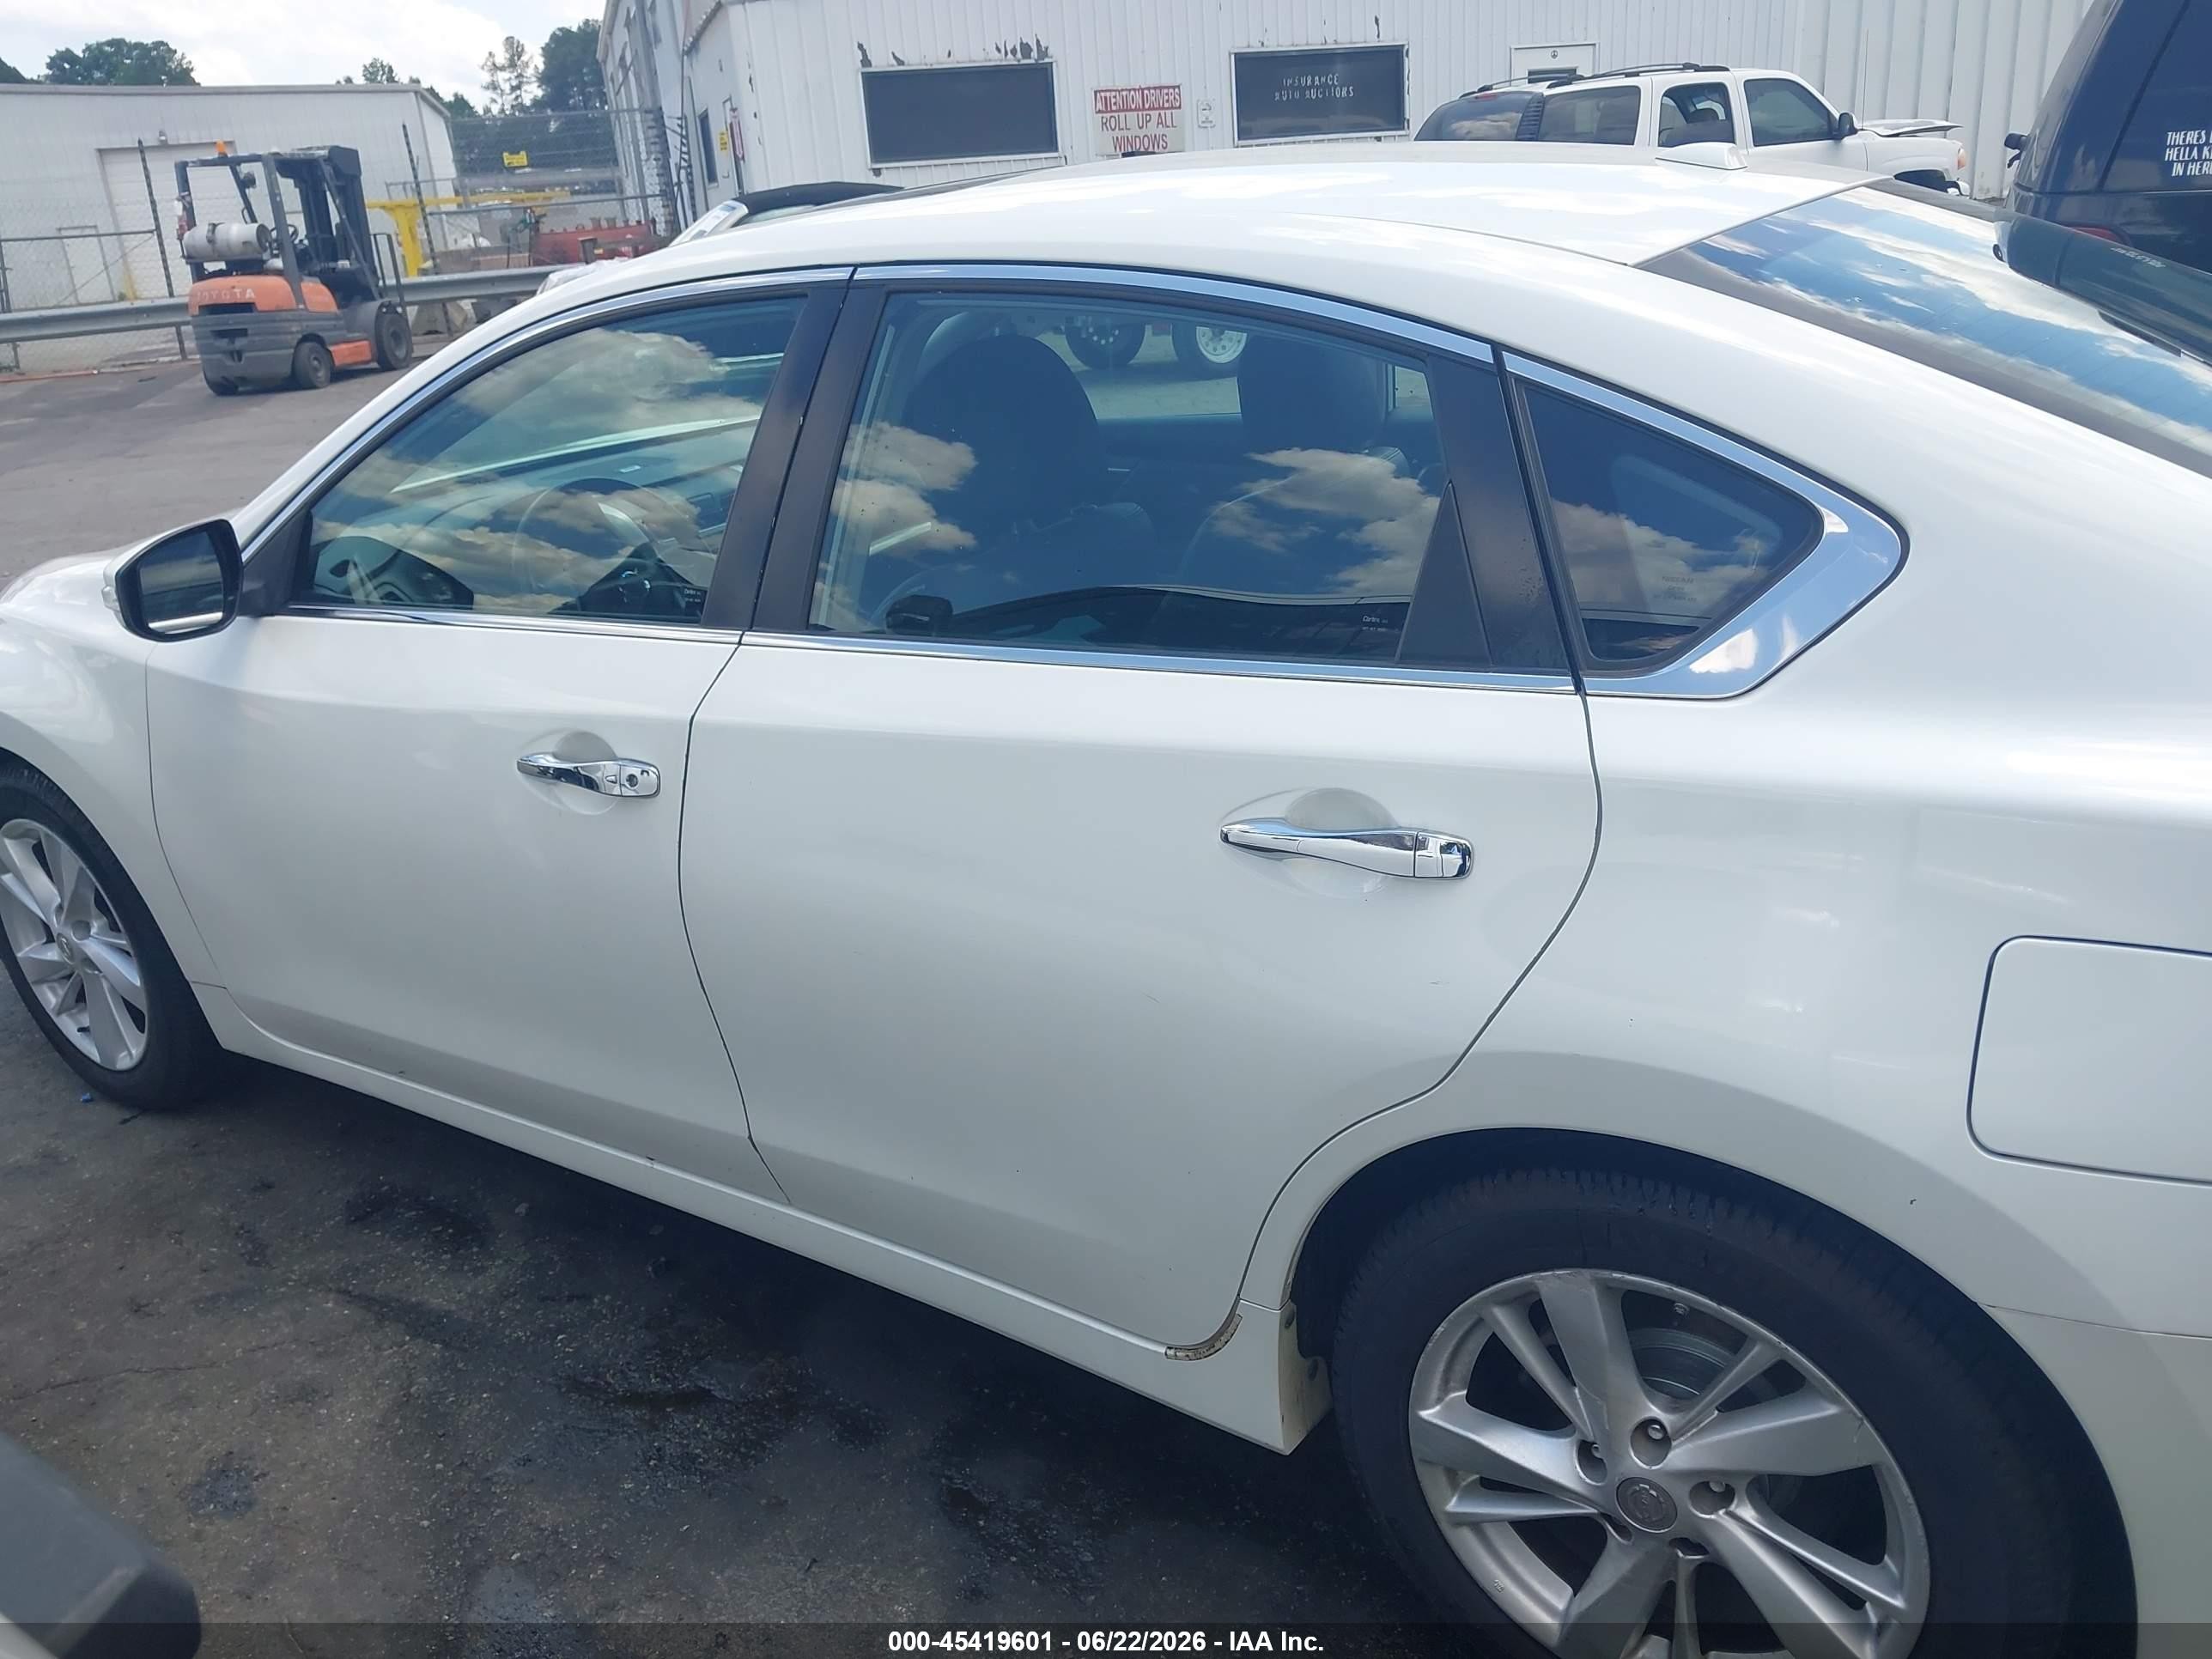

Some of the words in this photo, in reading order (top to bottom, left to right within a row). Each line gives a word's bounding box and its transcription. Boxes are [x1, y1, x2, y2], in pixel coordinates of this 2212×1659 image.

[1283, 74, 1339, 87] INSURANCE
[1095, 88, 1143, 112] ATTENTION
[1144, 88, 1181, 109] DRIVERS
[1305, 86, 1354, 100] AUCTIONS
[1101, 115, 1131, 131] ROLL
[1137, 113, 1152, 130] UP
[1156, 112, 1177, 129] ALL
[1113, 133, 1168, 153] WINDOWS
[2166, 130, 2206, 146] THERES
[2165, 146, 2198, 161] HELLA
[2172, 161, 2185, 177] IN
